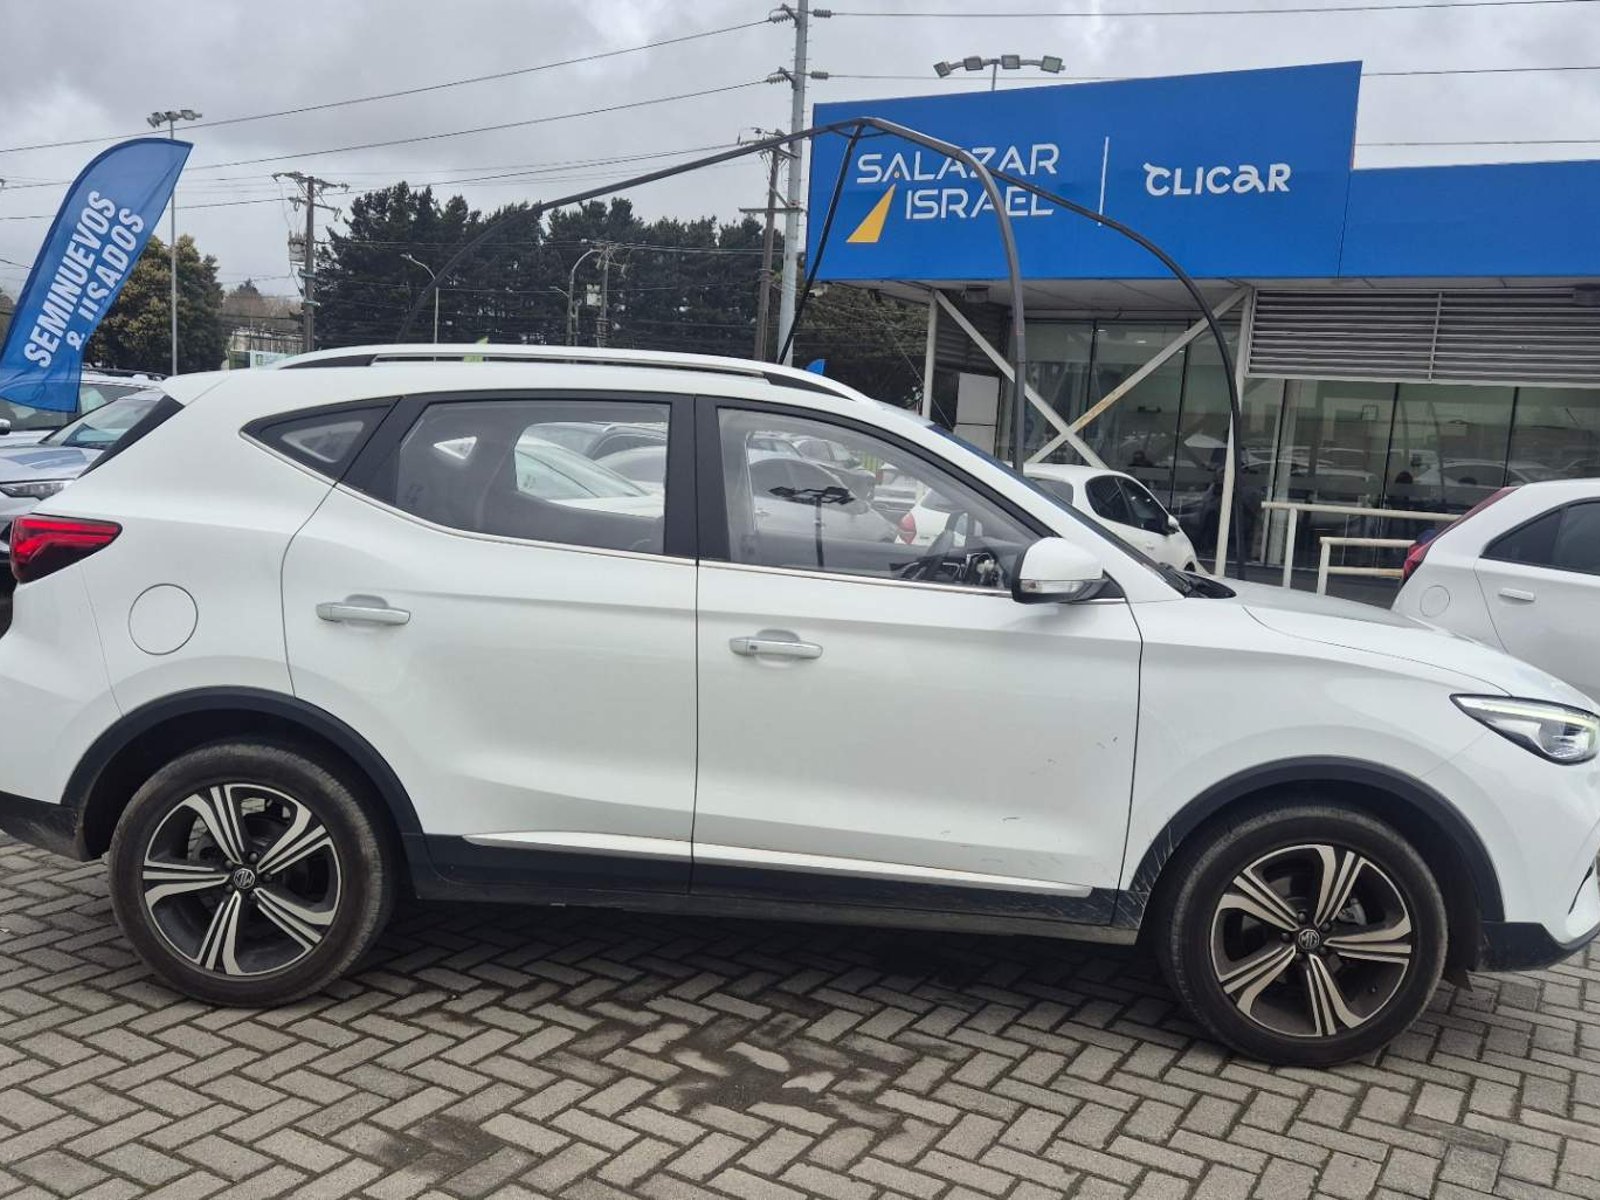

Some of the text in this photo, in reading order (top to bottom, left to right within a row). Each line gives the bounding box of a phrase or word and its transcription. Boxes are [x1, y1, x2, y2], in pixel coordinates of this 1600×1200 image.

[857, 143, 1060, 184] SALAZAR
[905, 185, 1055, 220] ISRAEL
[23, 190, 116, 368] SEMINUEVOS
[66, 330, 86, 351] &
[1298, 929, 1320, 950] MG
